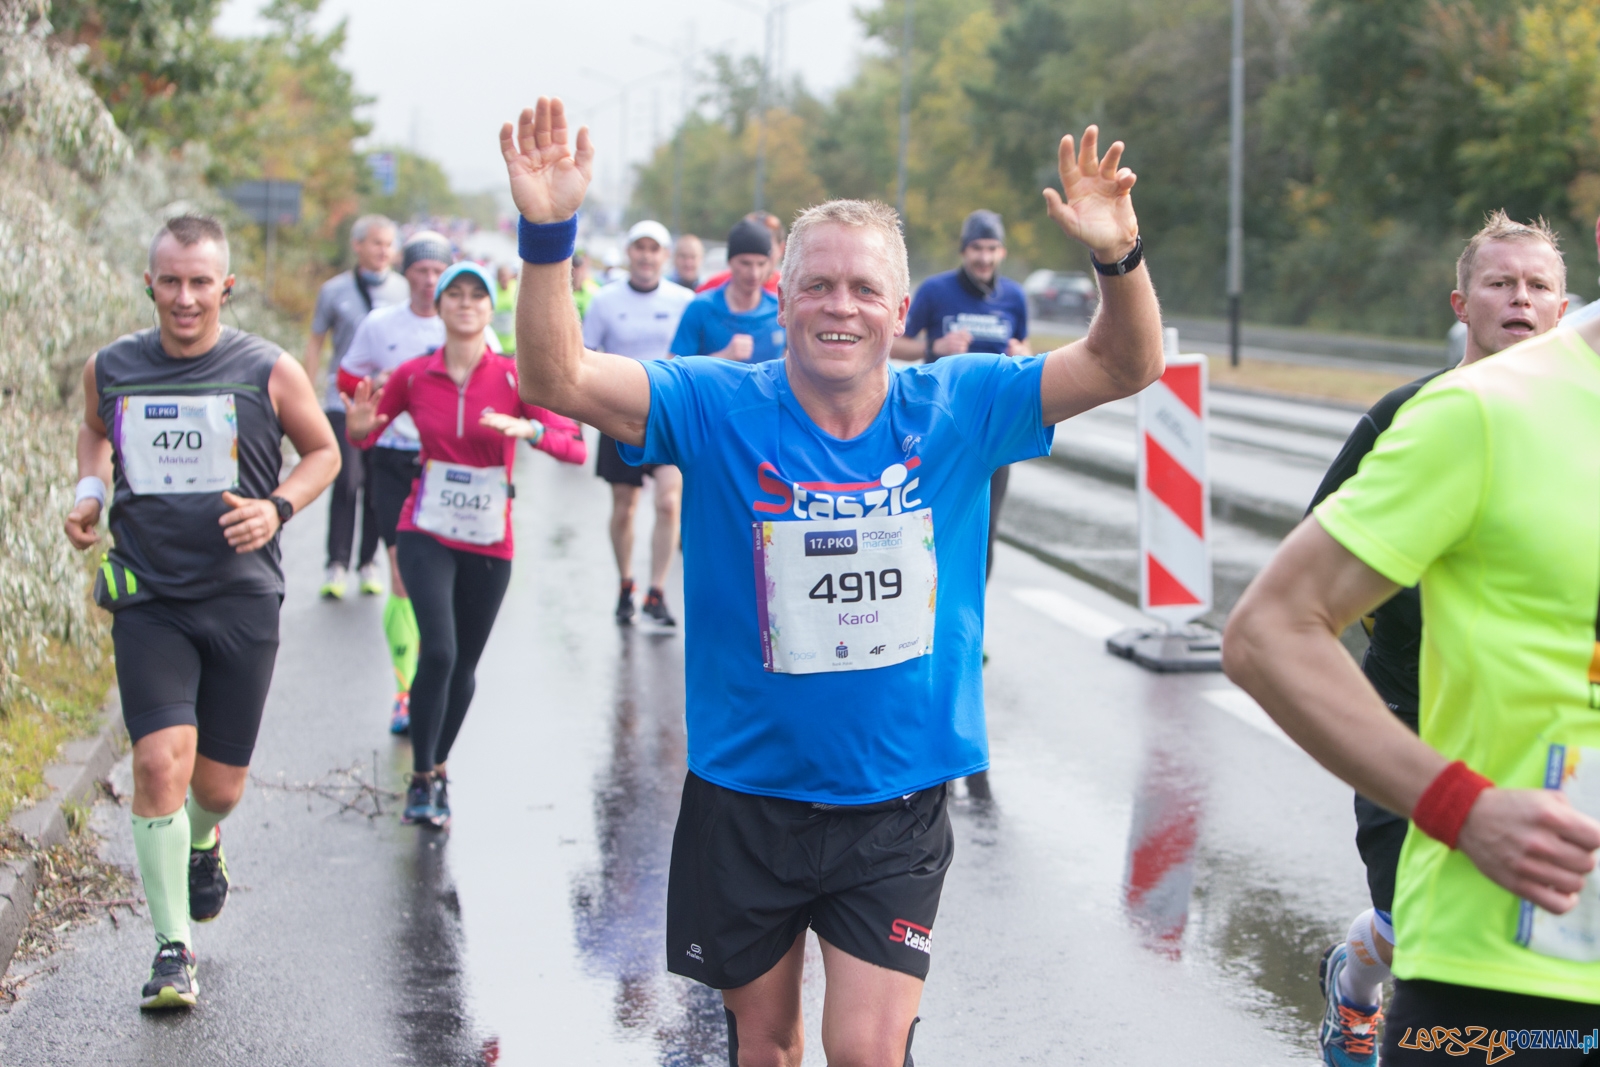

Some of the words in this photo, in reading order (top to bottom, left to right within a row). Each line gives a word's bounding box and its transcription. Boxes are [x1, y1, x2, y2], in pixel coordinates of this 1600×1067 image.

[152, 430, 203, 450] 470
[158, 455, 199, 465] Mariusz
[752, 456, 922, 520] Staszic
[440, 489, 491, 511] 5042
[809, 538, 826, 549] 17.
[827, 537, 854, 549] PKO
[862, 538, 903, 549] maraton
[808, 568, 902, 604] 4919
[838, 610, 879, 626] Karol
[869, 644, 887, 655] 4F
